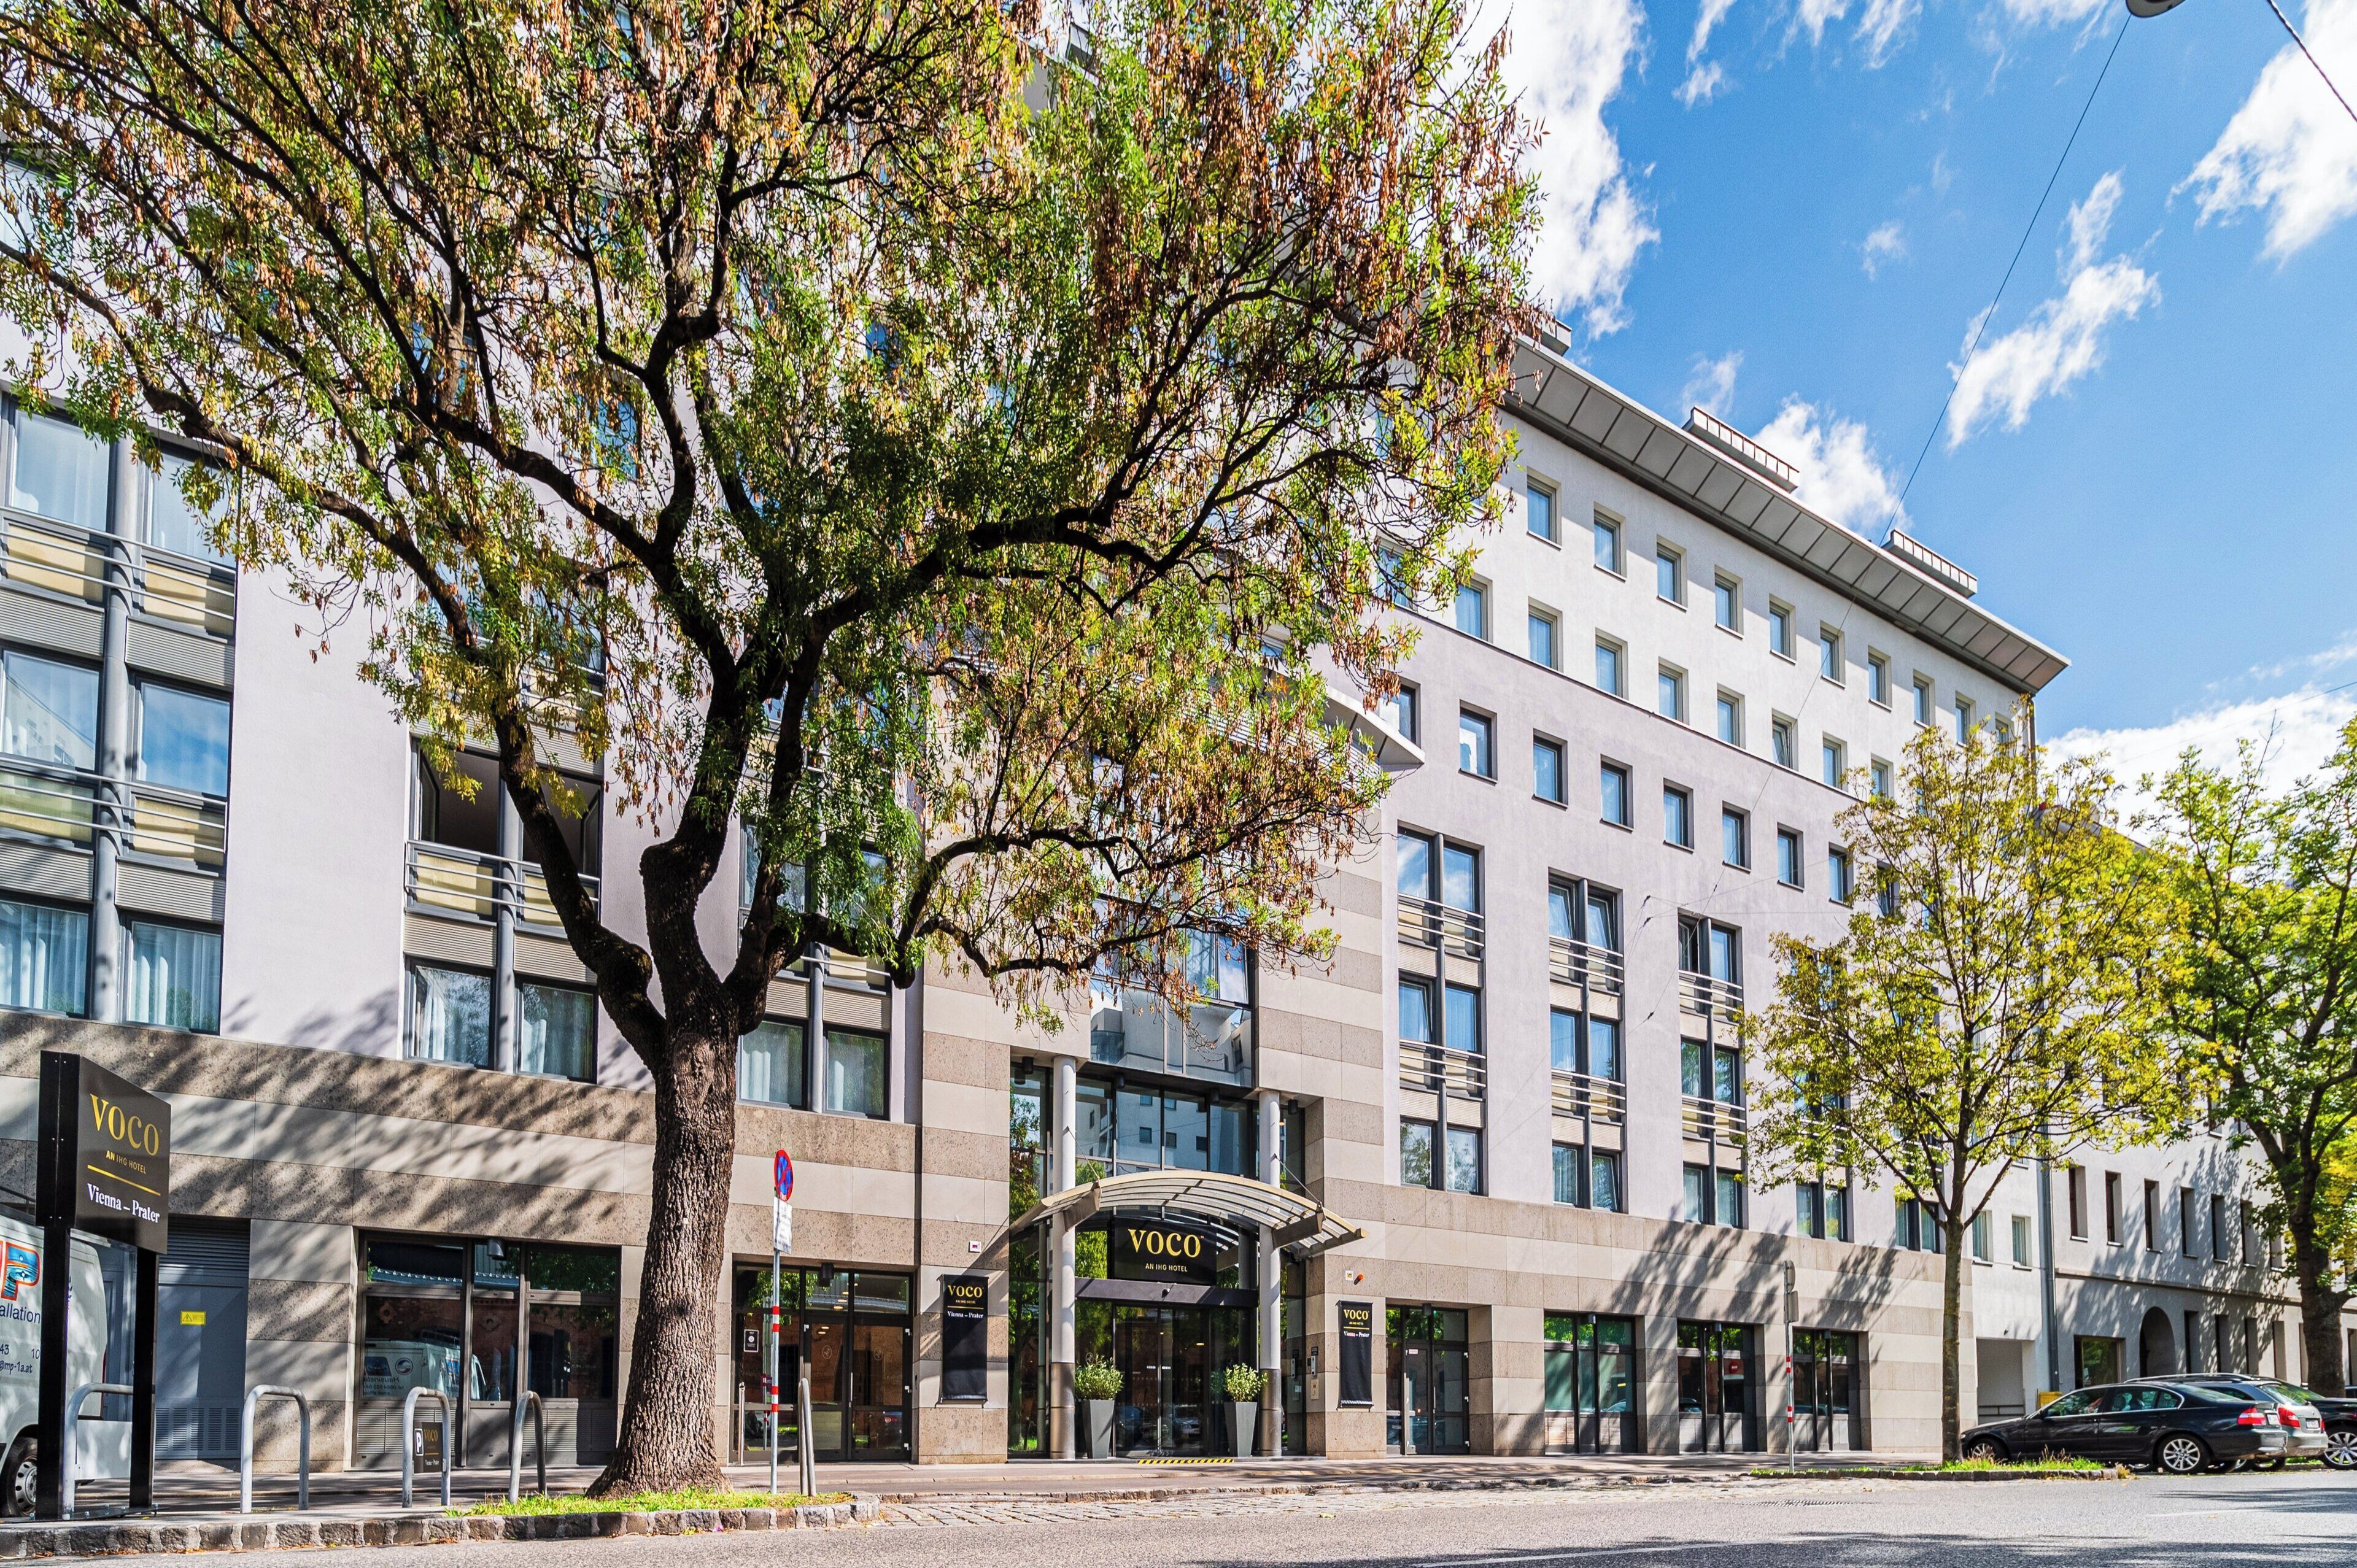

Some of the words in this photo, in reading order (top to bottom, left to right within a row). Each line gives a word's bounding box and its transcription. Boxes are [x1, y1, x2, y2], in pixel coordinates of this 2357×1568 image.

[106, 1150, 115, 1161] AN
[116, 1154, 127, 1166] IHG
[129, 1159, 147, 1175] HOTEL
[87, 1183, 122, 1211] Vienna
[132, 1200, 160, 1223] Prater
